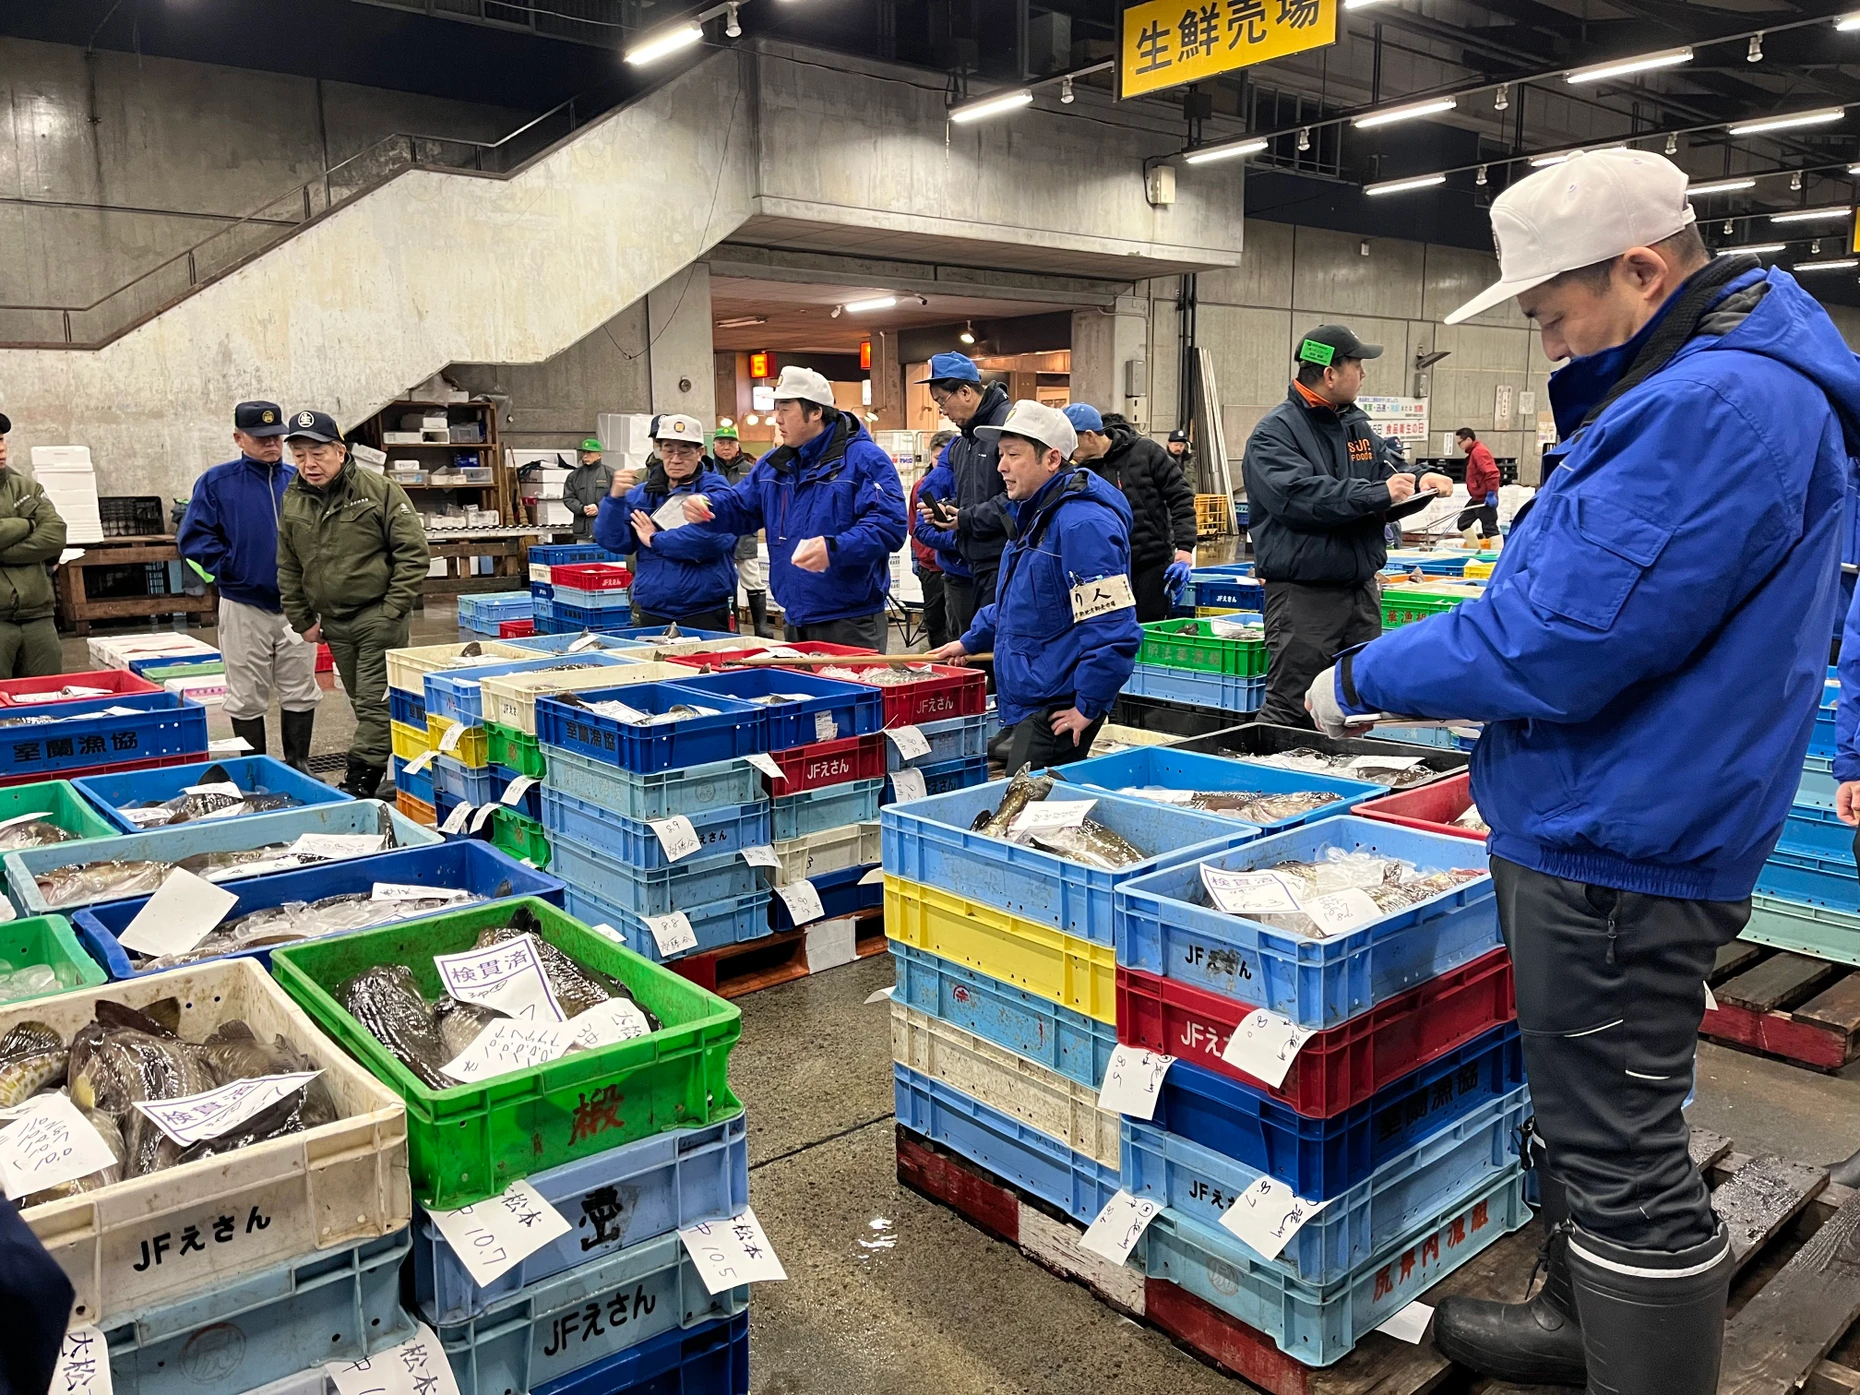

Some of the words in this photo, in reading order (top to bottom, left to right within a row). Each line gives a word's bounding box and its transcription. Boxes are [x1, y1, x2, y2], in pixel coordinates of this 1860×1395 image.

[1135, 0, 1320, 76] 生鮮売場
[916, 694, 954, 714] JFえさん
[13, 730, 139, 764] 室蘭漁協
[566, 721, 616, 752] 室蘭漁協
[806, 758, 850, 780] JFえさん
[699, 829, 728, 846] えさん
[451, 949, 528, 984] 検貫済
[1184, 944, 1252, 980] JFん
[1180, 1020, 1235, 1057] JFえ
[1188, 1179, 1239, 1212] JFえ
[132, 1204, 272, 1273] JFえさん
[543, 1283, 656, 1358] JFえさん
[401, 1338, 441, 1395] 松本
